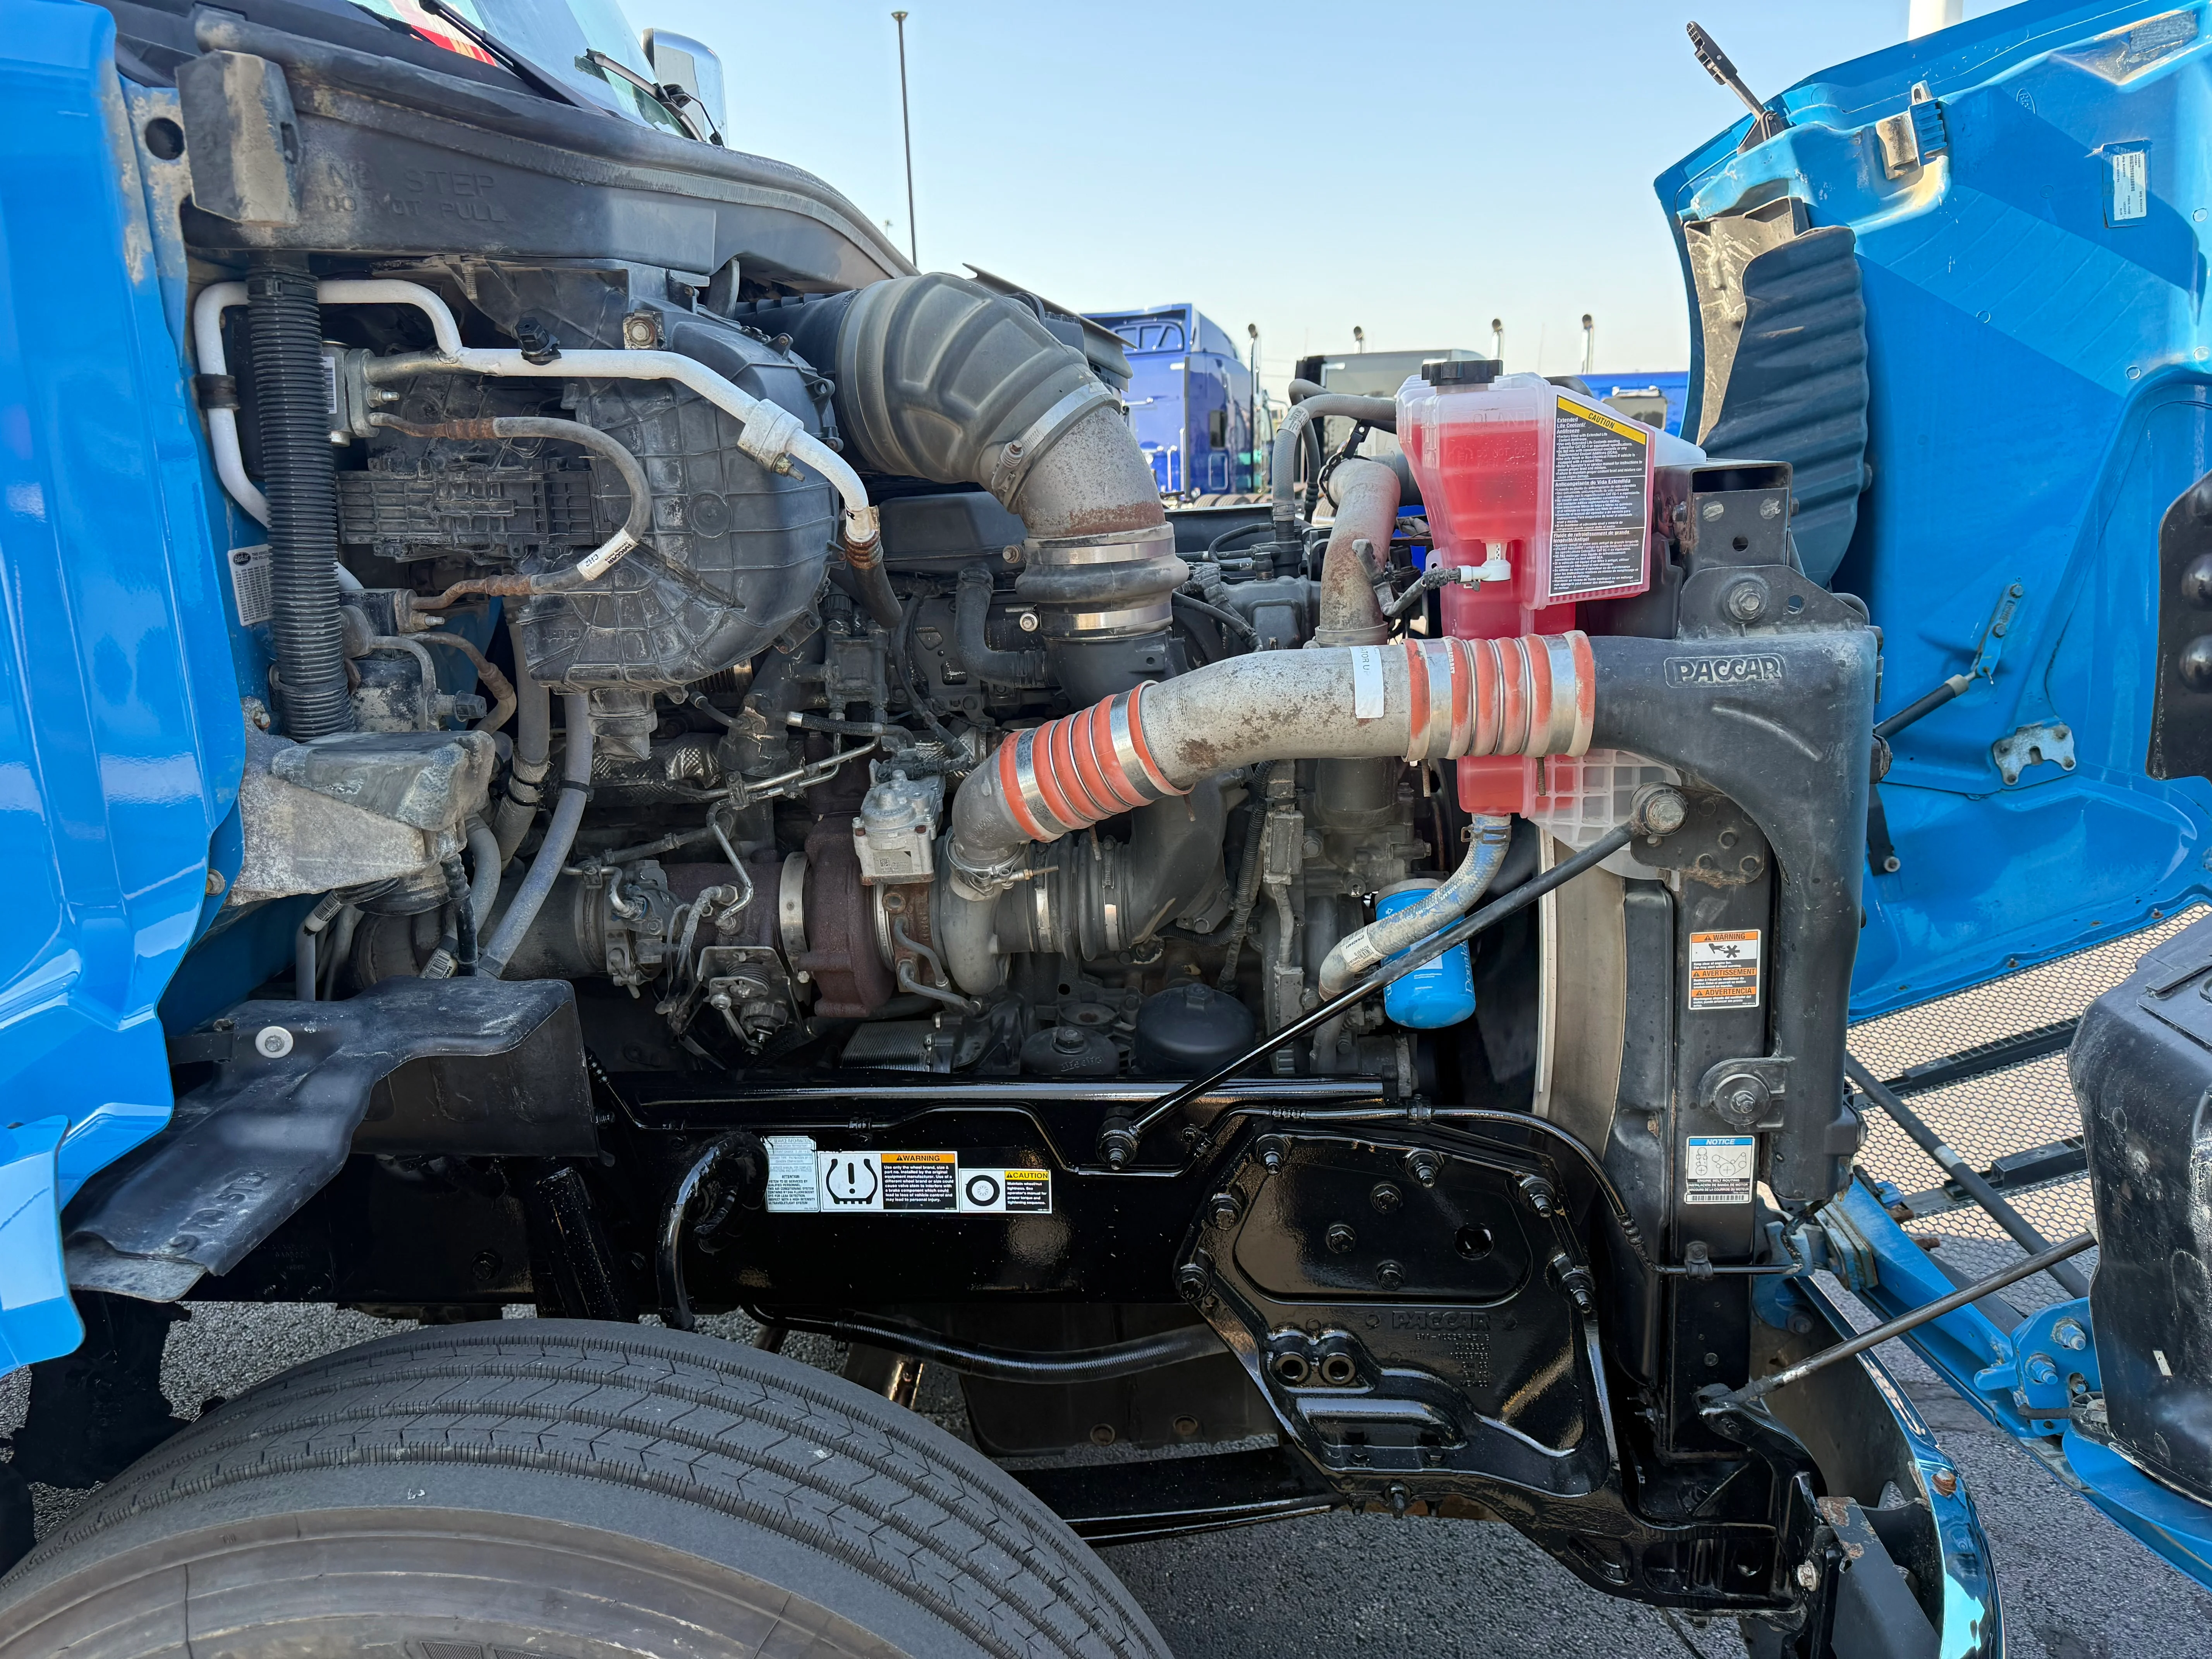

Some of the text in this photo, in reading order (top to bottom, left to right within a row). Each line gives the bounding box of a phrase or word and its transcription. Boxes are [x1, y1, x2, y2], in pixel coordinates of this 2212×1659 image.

[404, 167, 494, 197] STEP
[372, 199, 422, 216] NOT
[441, 202, 507, 222] PULL
[1448, 411, 1530, 431] COOLANT
[1588, 412, 1615, 429] CAUTION
[1493, 448, 1510, 458] NOT
[1515, 446, 1536, 455] OPEN
[584, 554, 599, 567] CH2
[608, 543, 632, 564] PACCAR
[1674, 658, 1782, 682] PACCAR
[1460, 940, 1472, 994] Donald
[1702, 969, 1755, 977] AVERTISSEMENT
[1392, 1310, 1491, 1331] PACCAR
